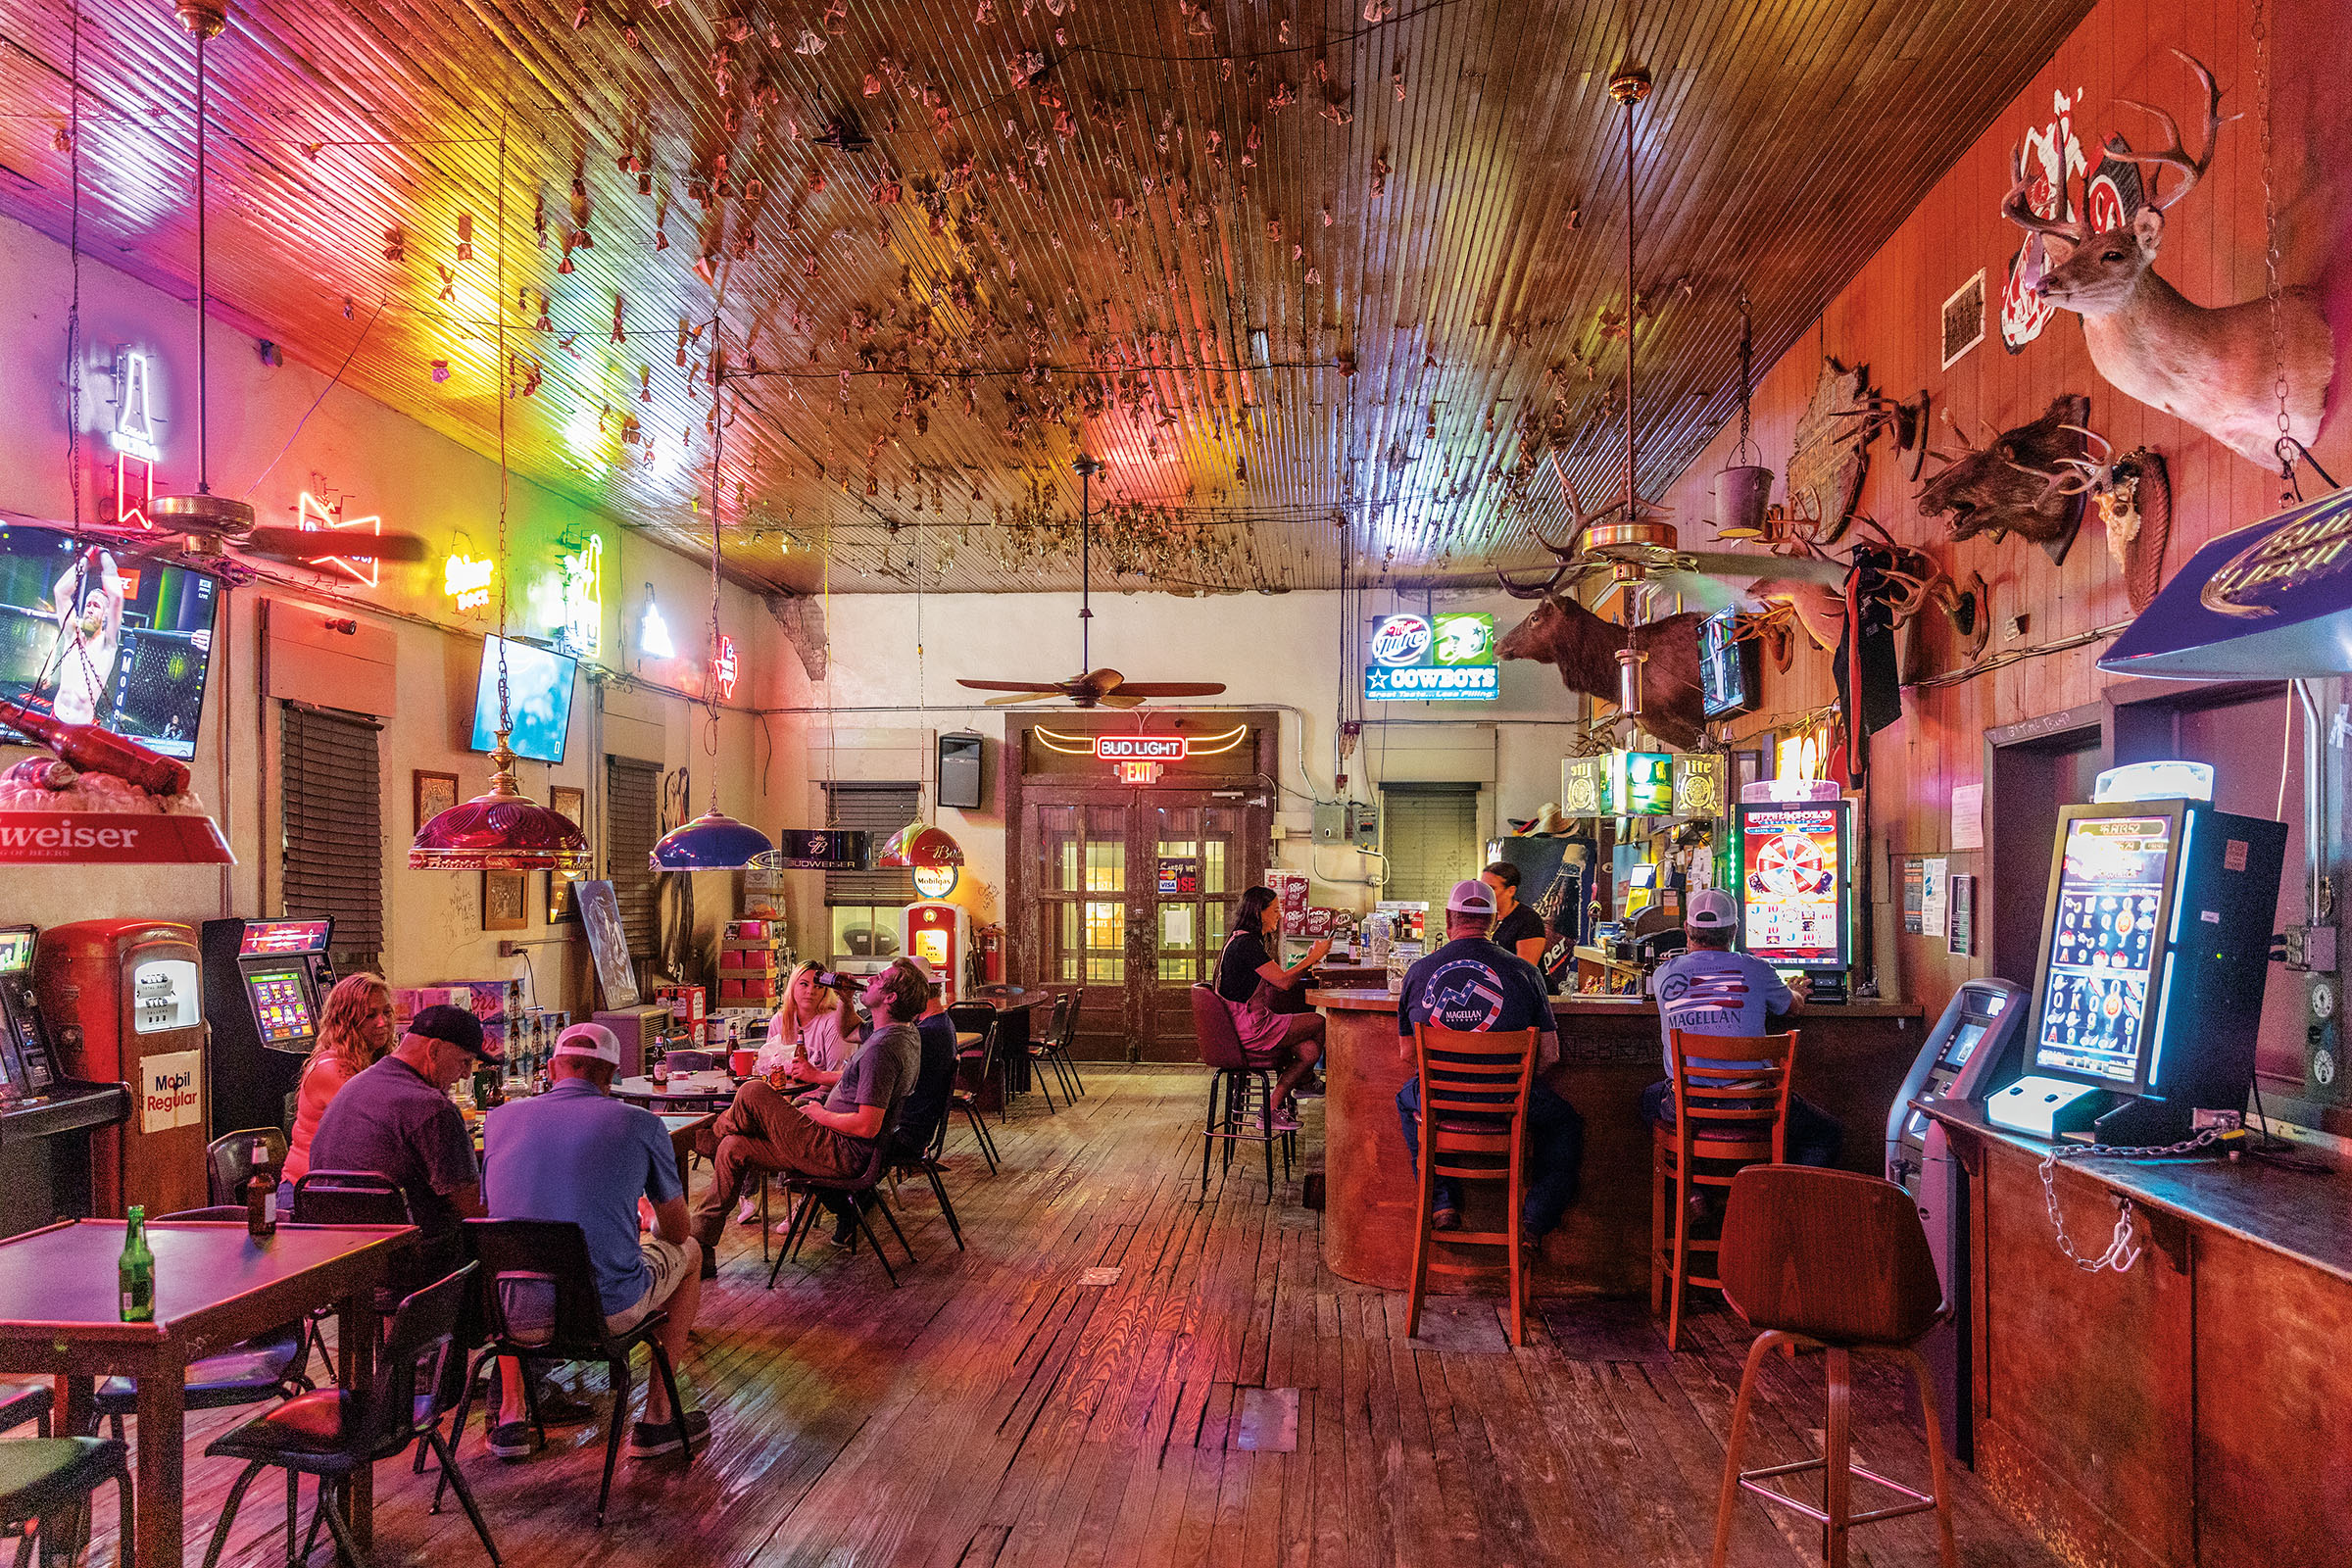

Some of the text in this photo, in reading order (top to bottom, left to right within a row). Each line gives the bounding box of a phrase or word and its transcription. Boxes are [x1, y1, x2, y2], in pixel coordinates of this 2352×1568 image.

[1390, 667, 1496, 688] COWBOYS
[111, 654, 133, 735] Model
[1101, 741, 1180, 755] BUD LIGHT
[1127, 761, 1152, 782] EXIT
[1684, 760, 1712, 776] Lite
[0, 819, 139, 849] weiser
[917, 877, 951, 886] Mobilgas
[1543, 937, 1567, 975] per
[2078, 949, 2087, 962] 9
[2071, 994, 2082, 1010] K
[1446, 1010, 1482, 1019] MAGELLAN
[1669, 1010, 1741, 1028] MAGELLAN
[2048, 1026, 2057, 1043] A
[2125, 1017, 2134, 1035] 9
[2067, 1028, 2076, 1044] 9
[155, 1070, 190, 1092] Mobil
[147, 1091, 198, 1113] Regular
